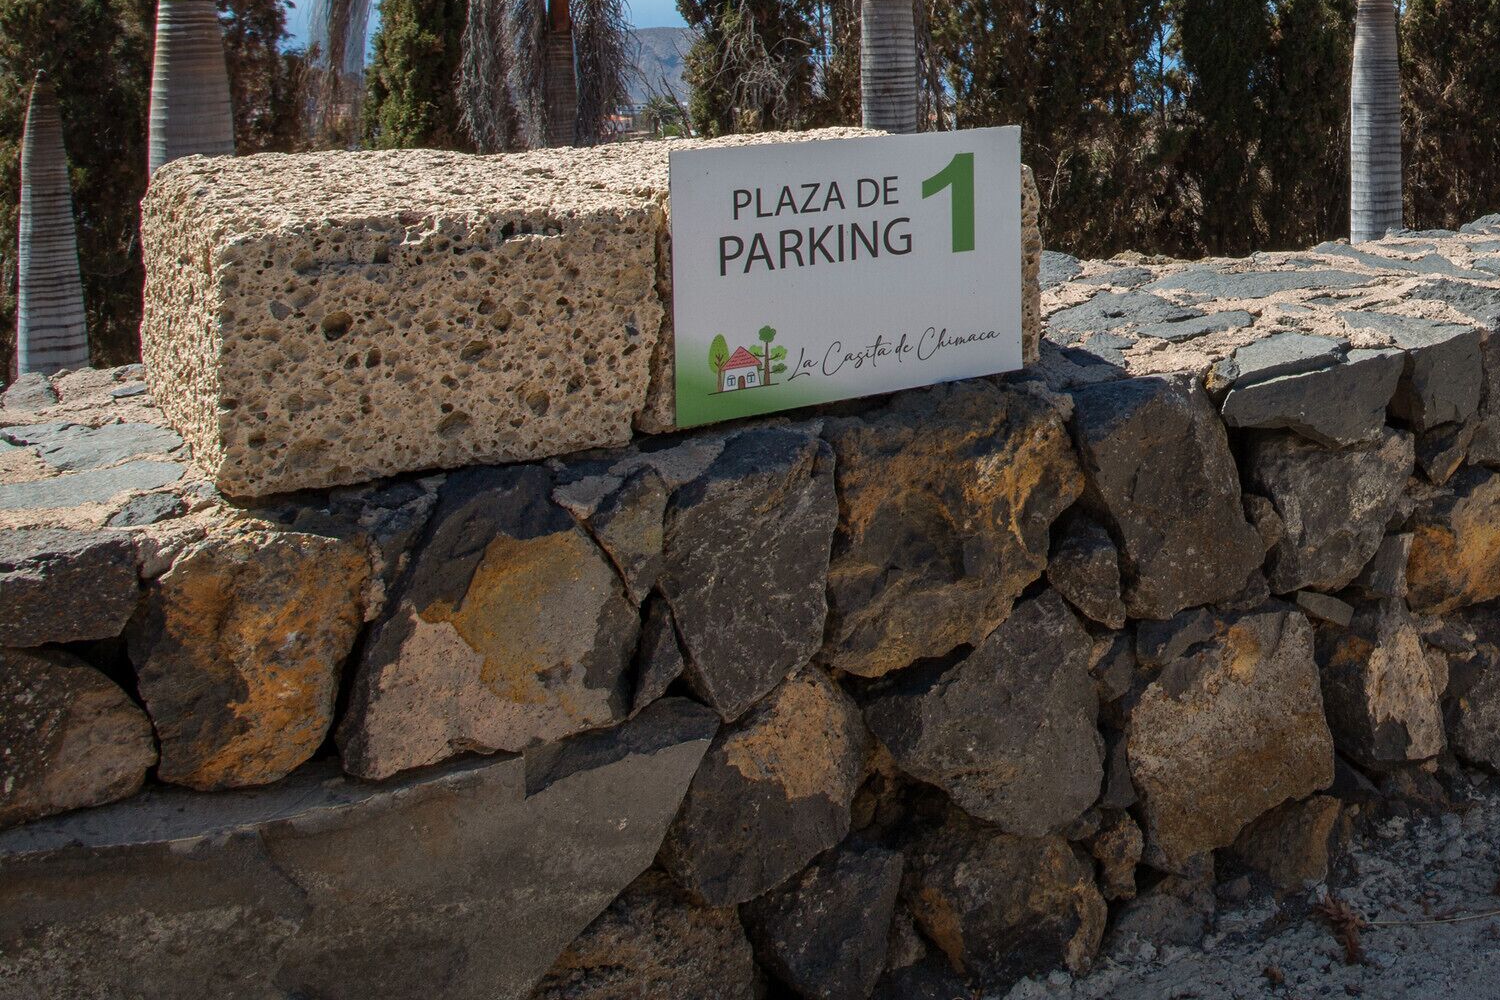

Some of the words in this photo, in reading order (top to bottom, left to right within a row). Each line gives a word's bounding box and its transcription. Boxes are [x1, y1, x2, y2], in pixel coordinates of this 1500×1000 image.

[733, 180, 846, 220] PLAZA
[857, 175, 900, 208] DE
[921, 151, 975, 253] 1
[719, 217, 913, 276] PARKING
[787, 347, 819, 382] La
[822, 335, 892, 376] Casita
[894, 333, 914, 363] de
[917, 326, 1001, 361] Chimaca
